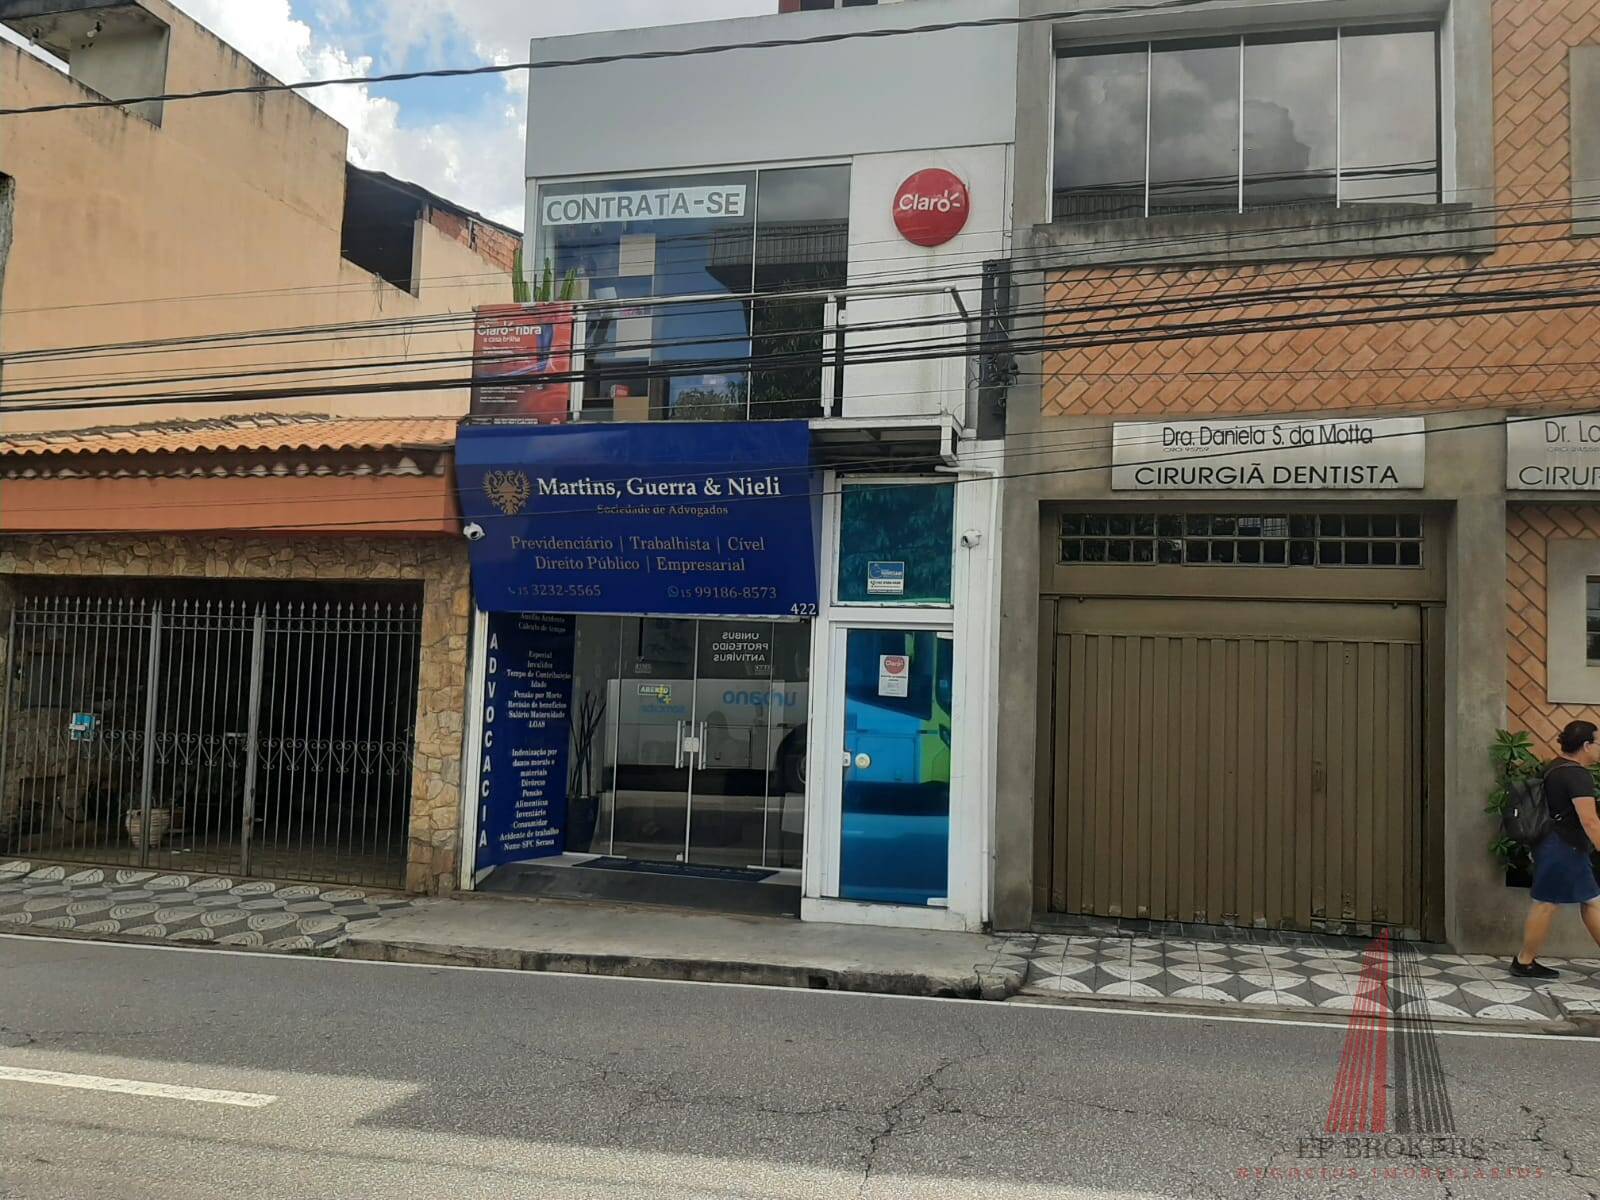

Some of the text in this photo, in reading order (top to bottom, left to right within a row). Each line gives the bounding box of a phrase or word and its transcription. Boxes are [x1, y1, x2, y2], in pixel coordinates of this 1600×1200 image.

[546, 191, 741, 222] CONTRATA-SE
[899, 190, 956, 212] Claro
[1162, 424, 1373, 446] Dra. Daniela S. da Motta
[1545, 420, 1570, 442] Dr.
[1135, 463, 1399, 485] CIRURGIÃ DENTISTA
[536, 476, 781, 498] Martins, Guerra & Nieli
[596, 504, 728, 517] Sociedade de Advogados
[511, 536, 765, 551] Previdenciário Trabalhista Cível
[536, 556, 745, 574] Direito Público Empresarial
[532, 584, 601, 596] 3232-5565
[694, 586, 777, 599] 99186-8573
[790, 602, 816, 615] 422
[479, 632, 498, 846] ADVOCACIA
